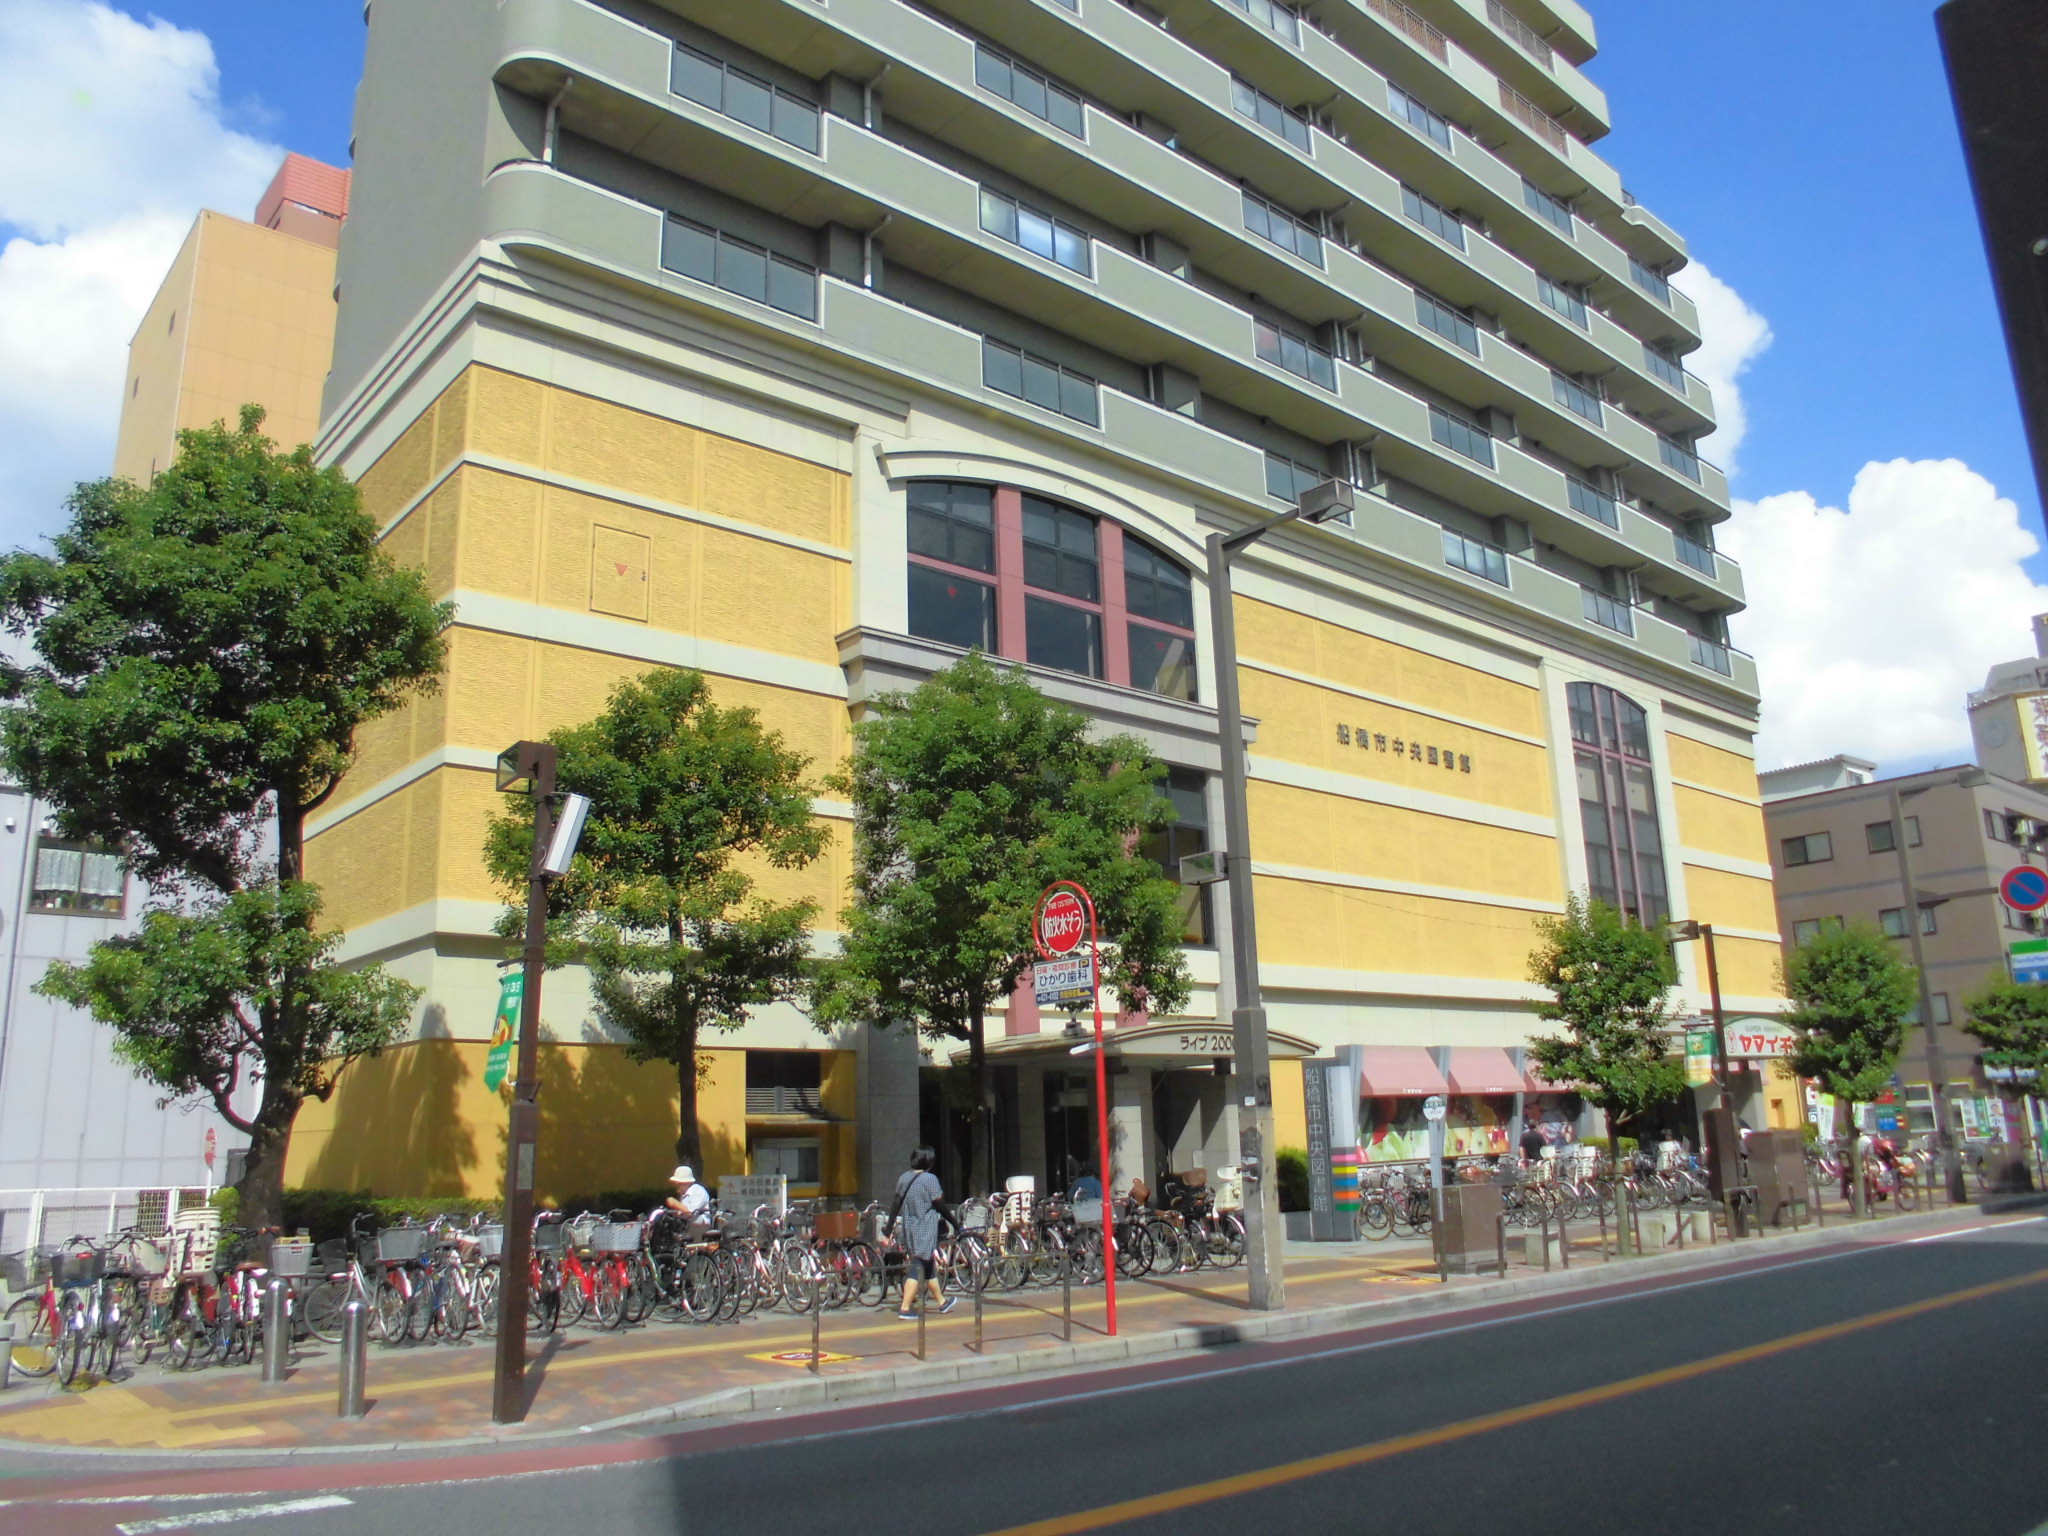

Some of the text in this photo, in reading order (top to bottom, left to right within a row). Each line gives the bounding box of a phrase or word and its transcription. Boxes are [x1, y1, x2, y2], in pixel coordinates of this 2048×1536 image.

[1045, 910, 1081, 939] 防火水そう
[1039, 968, 1088, 986] ひかり歯科
[1211, 1035, 1233, 1051] 200
